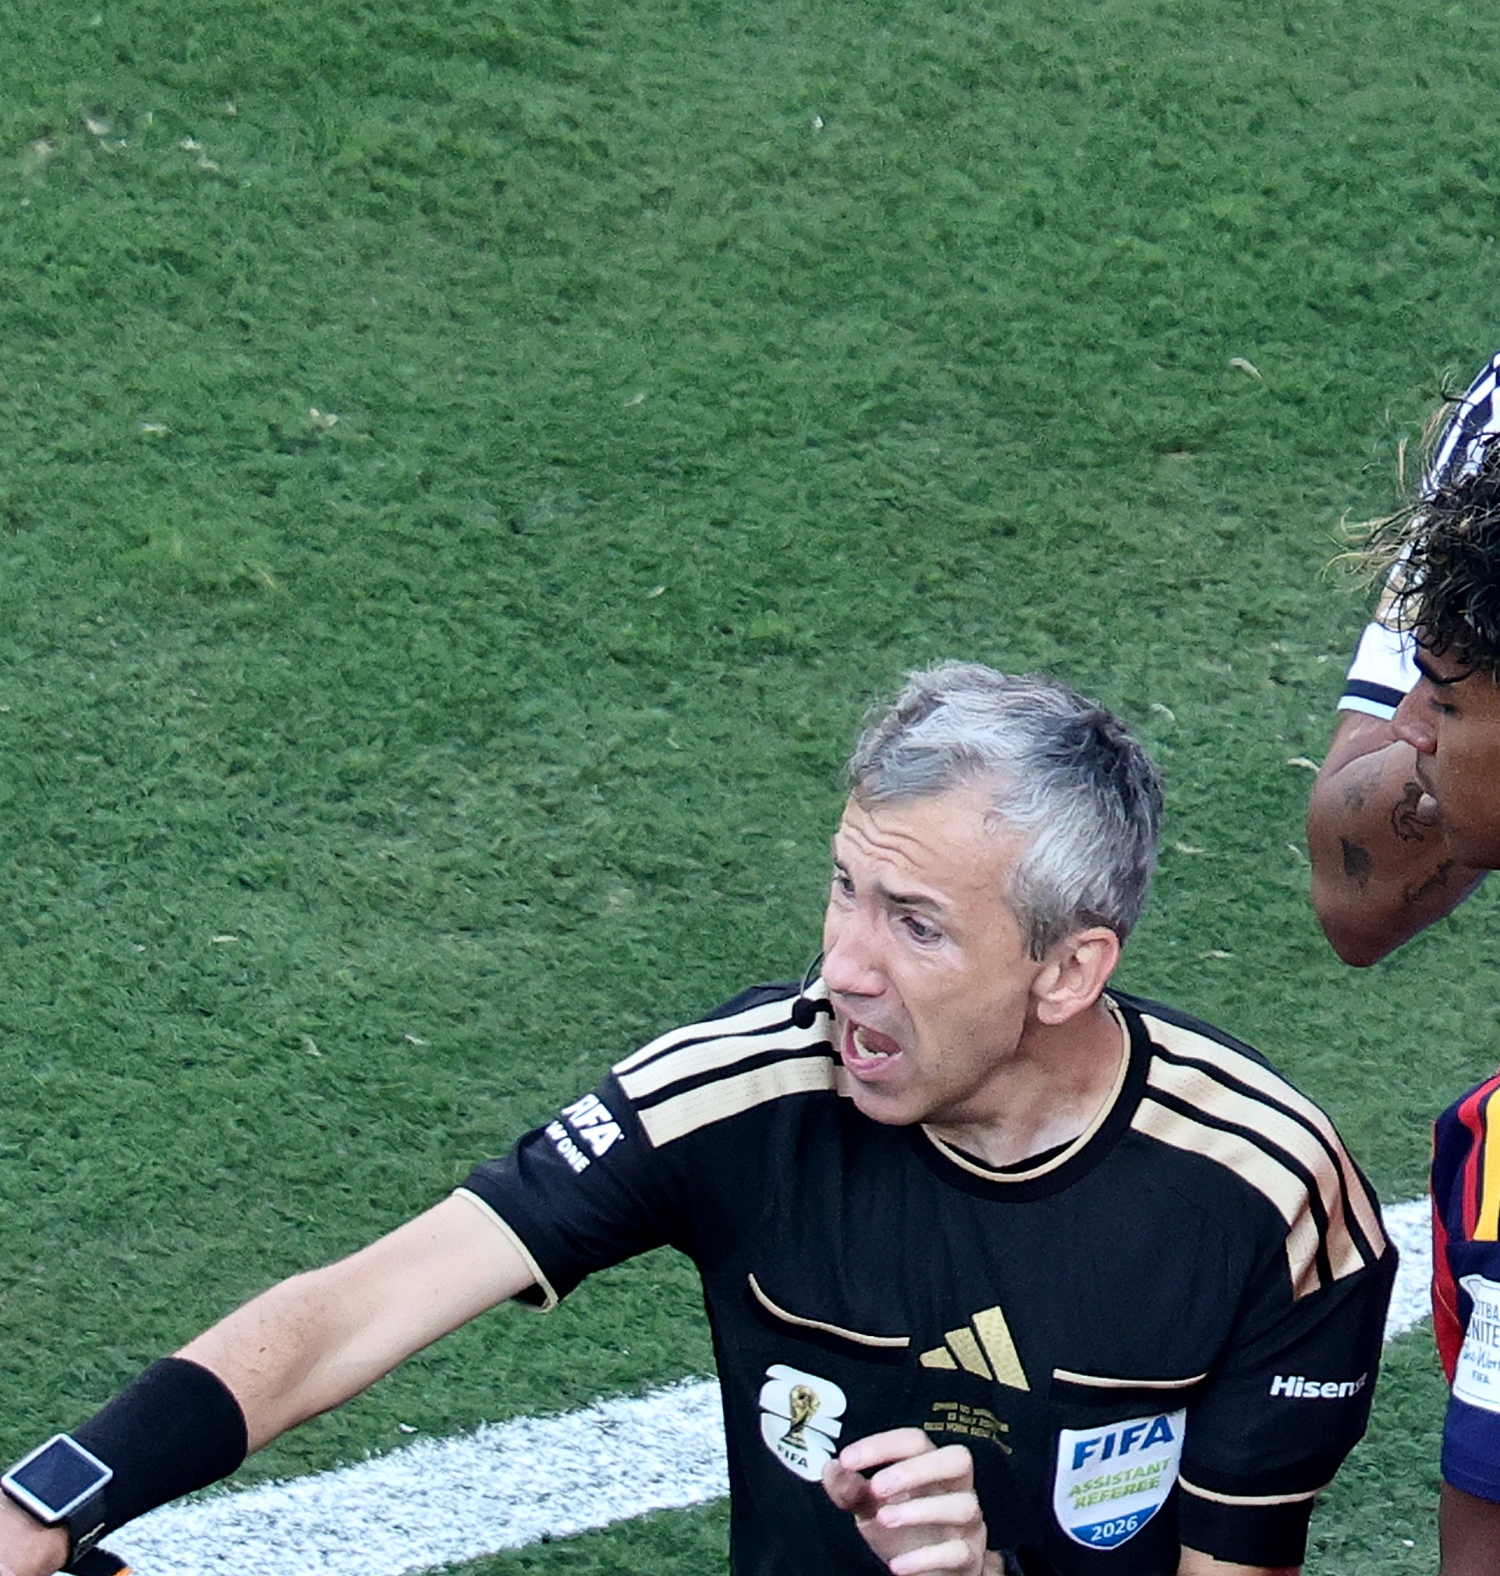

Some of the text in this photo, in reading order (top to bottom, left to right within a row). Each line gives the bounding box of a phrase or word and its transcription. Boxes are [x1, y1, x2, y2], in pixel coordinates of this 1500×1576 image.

[1269, 1372, 1368, 1398] Hisen
[1472, 1370, 1491, 1385] FIFA
[777, 1444, 808, 1468] FIFA
[1072, 1415, 1175, 1471] FIFA
[1068, 1457, 1171, 1497] ASSISTANT
[1073, 1476, 1161, 1510] REFEREE
[1091, 1515, 1138, 1541] 2026
